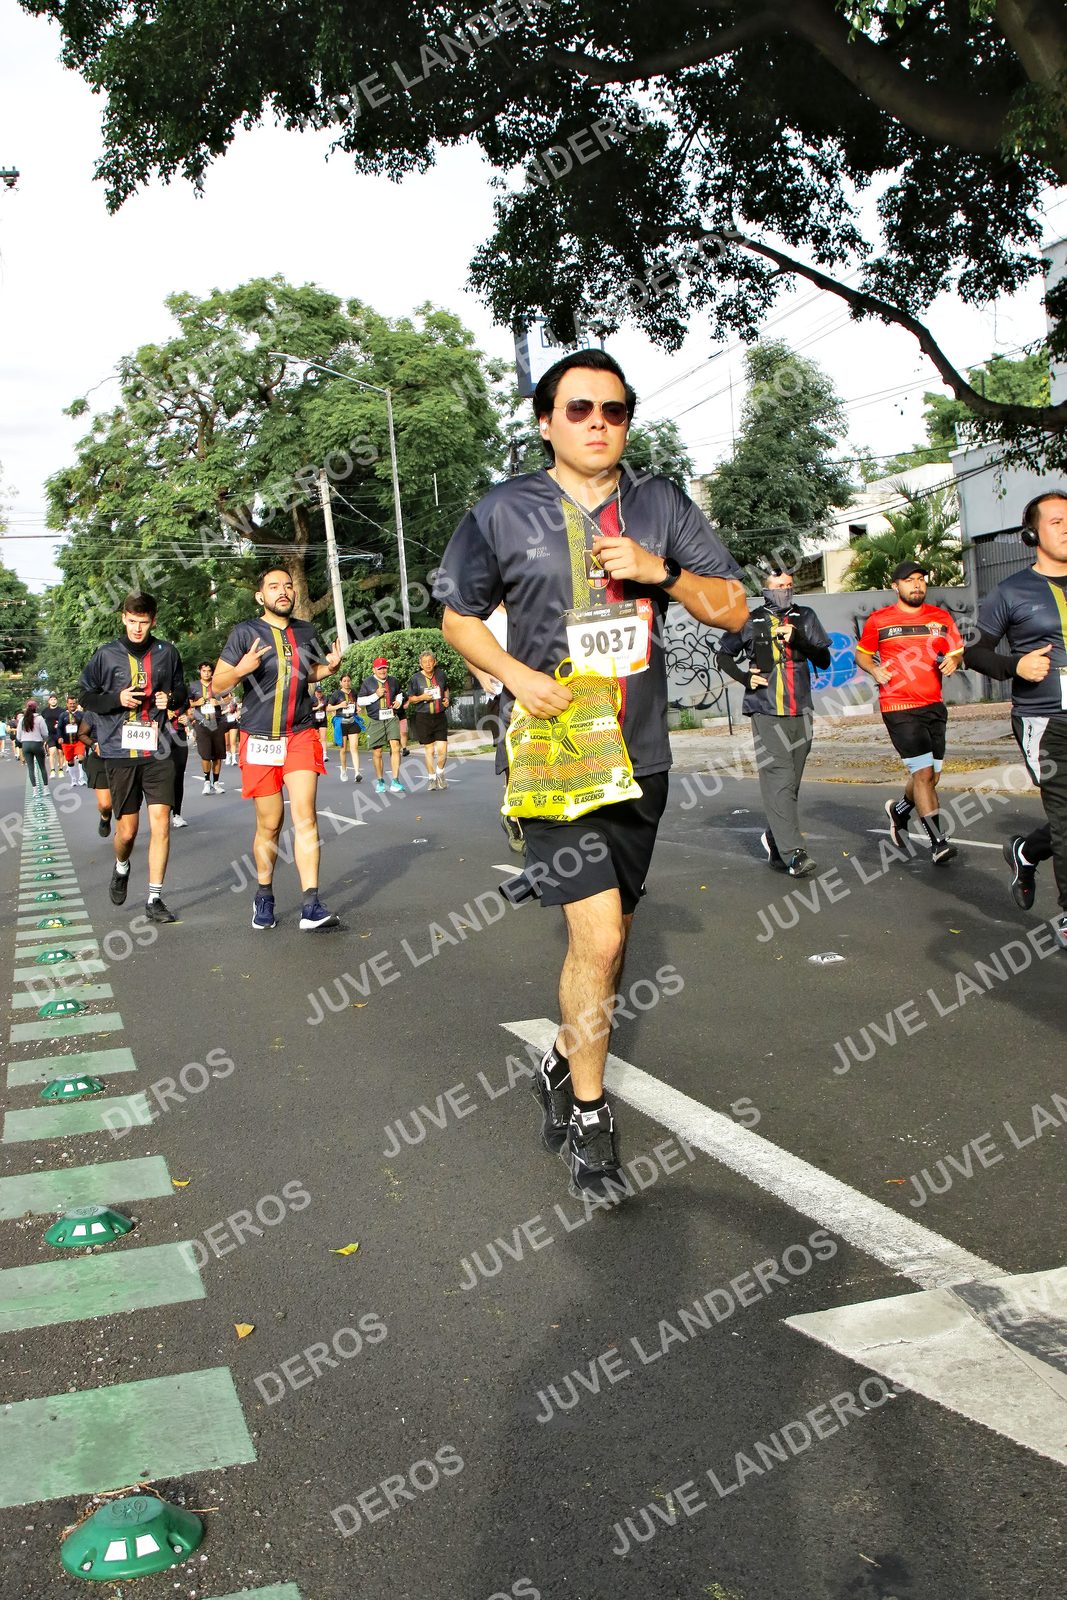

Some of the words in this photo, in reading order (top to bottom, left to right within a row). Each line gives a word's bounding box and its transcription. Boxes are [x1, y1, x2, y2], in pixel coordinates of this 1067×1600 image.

[580, 626, 637, 658] 9037
[127, 729, 151, 740] 8449
[250, 743, 282, 754] 13498
